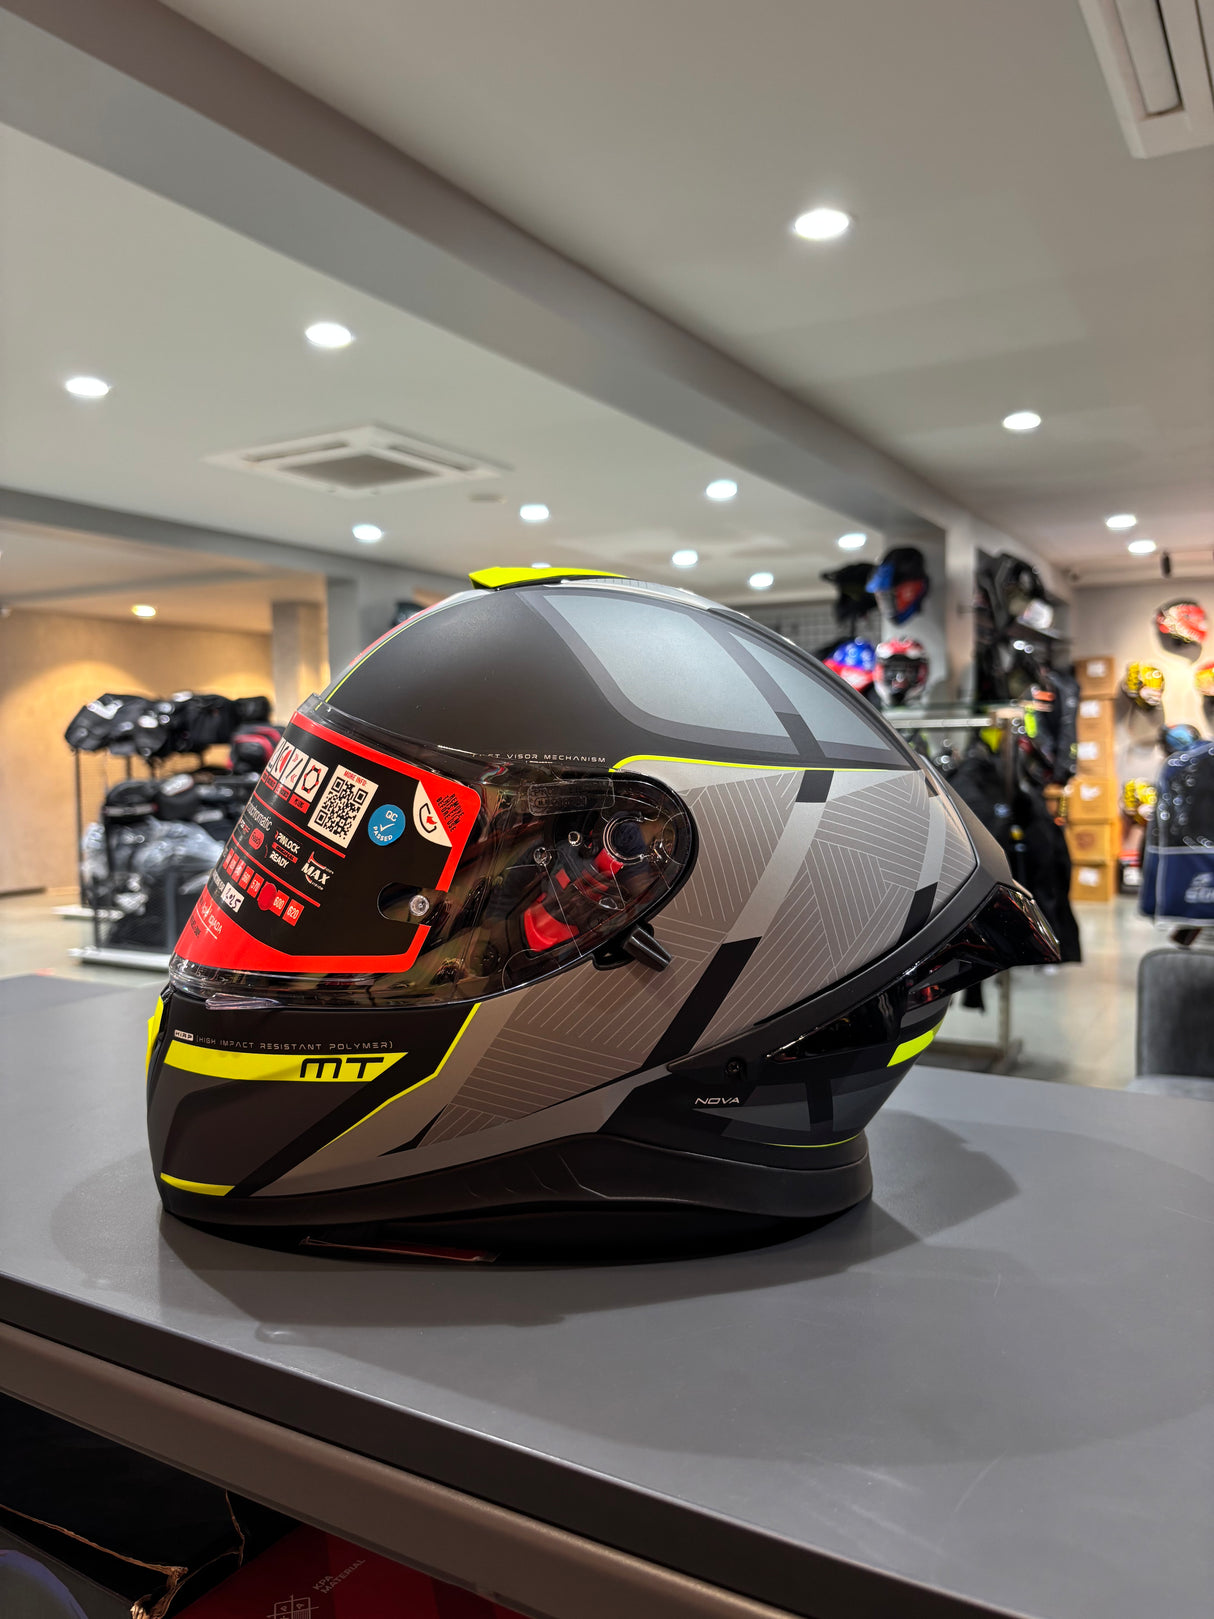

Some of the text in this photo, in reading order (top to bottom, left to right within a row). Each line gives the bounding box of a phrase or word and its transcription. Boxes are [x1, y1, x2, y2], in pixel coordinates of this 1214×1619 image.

[543, 753, 606, 763] MECHANISM
[385, 810, 399, 822] QC
[372, 825, 393, 842] PASSED
[276, 832, 301, 854] PINLOCK
[269, 850, 290, 869] READY
[301, 862, 330, 886] MAX
[273, 896, 285, 910] 600
[286, 905, 300, 920] 620
[220, 1040, 254, 1049] IMPACT
[260, 1042, 322, 1051] RESISTANT
[329, 1040, 394, 1050] POLYMER)
[299, 1056, 385, 1079] MT
[694, 1097, 740, 1105] NOVA
[312, 1575, 334, 1591] KPA
[320, 1559, 366, 1594] MATERIAL
